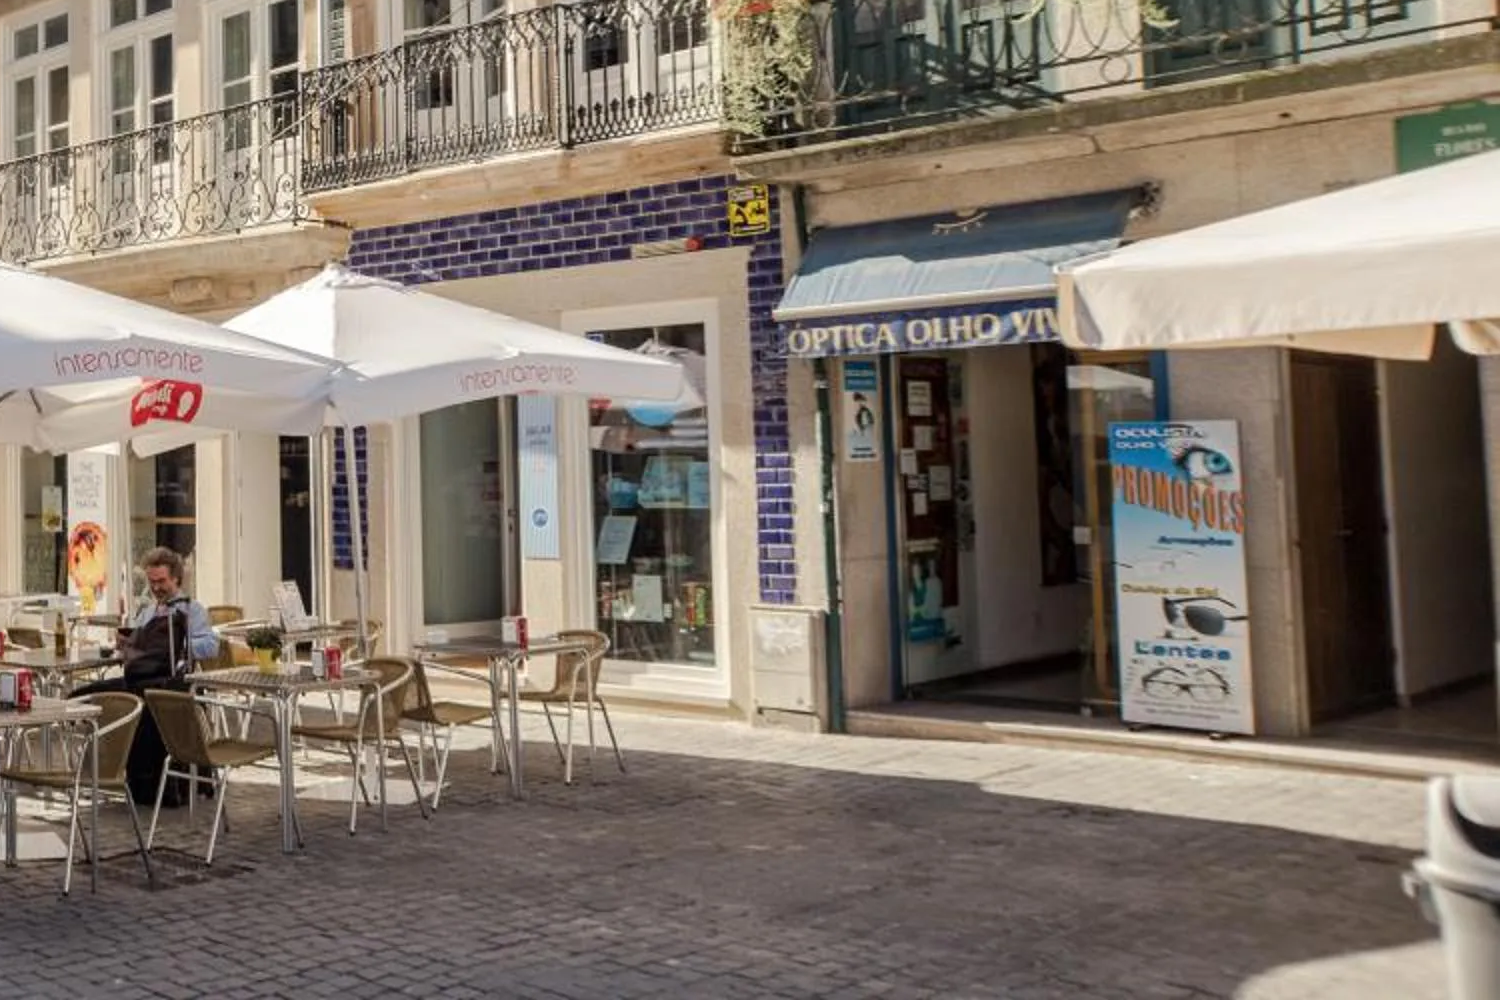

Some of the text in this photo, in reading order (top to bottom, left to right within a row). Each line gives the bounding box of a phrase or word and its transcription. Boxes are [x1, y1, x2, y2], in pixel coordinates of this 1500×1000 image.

[788, 321, 898, 354] ÓPTICA
[906, 312, 1001, 346] OLHO
[1112, 465, 1244, 534] PROMOÇÕES
